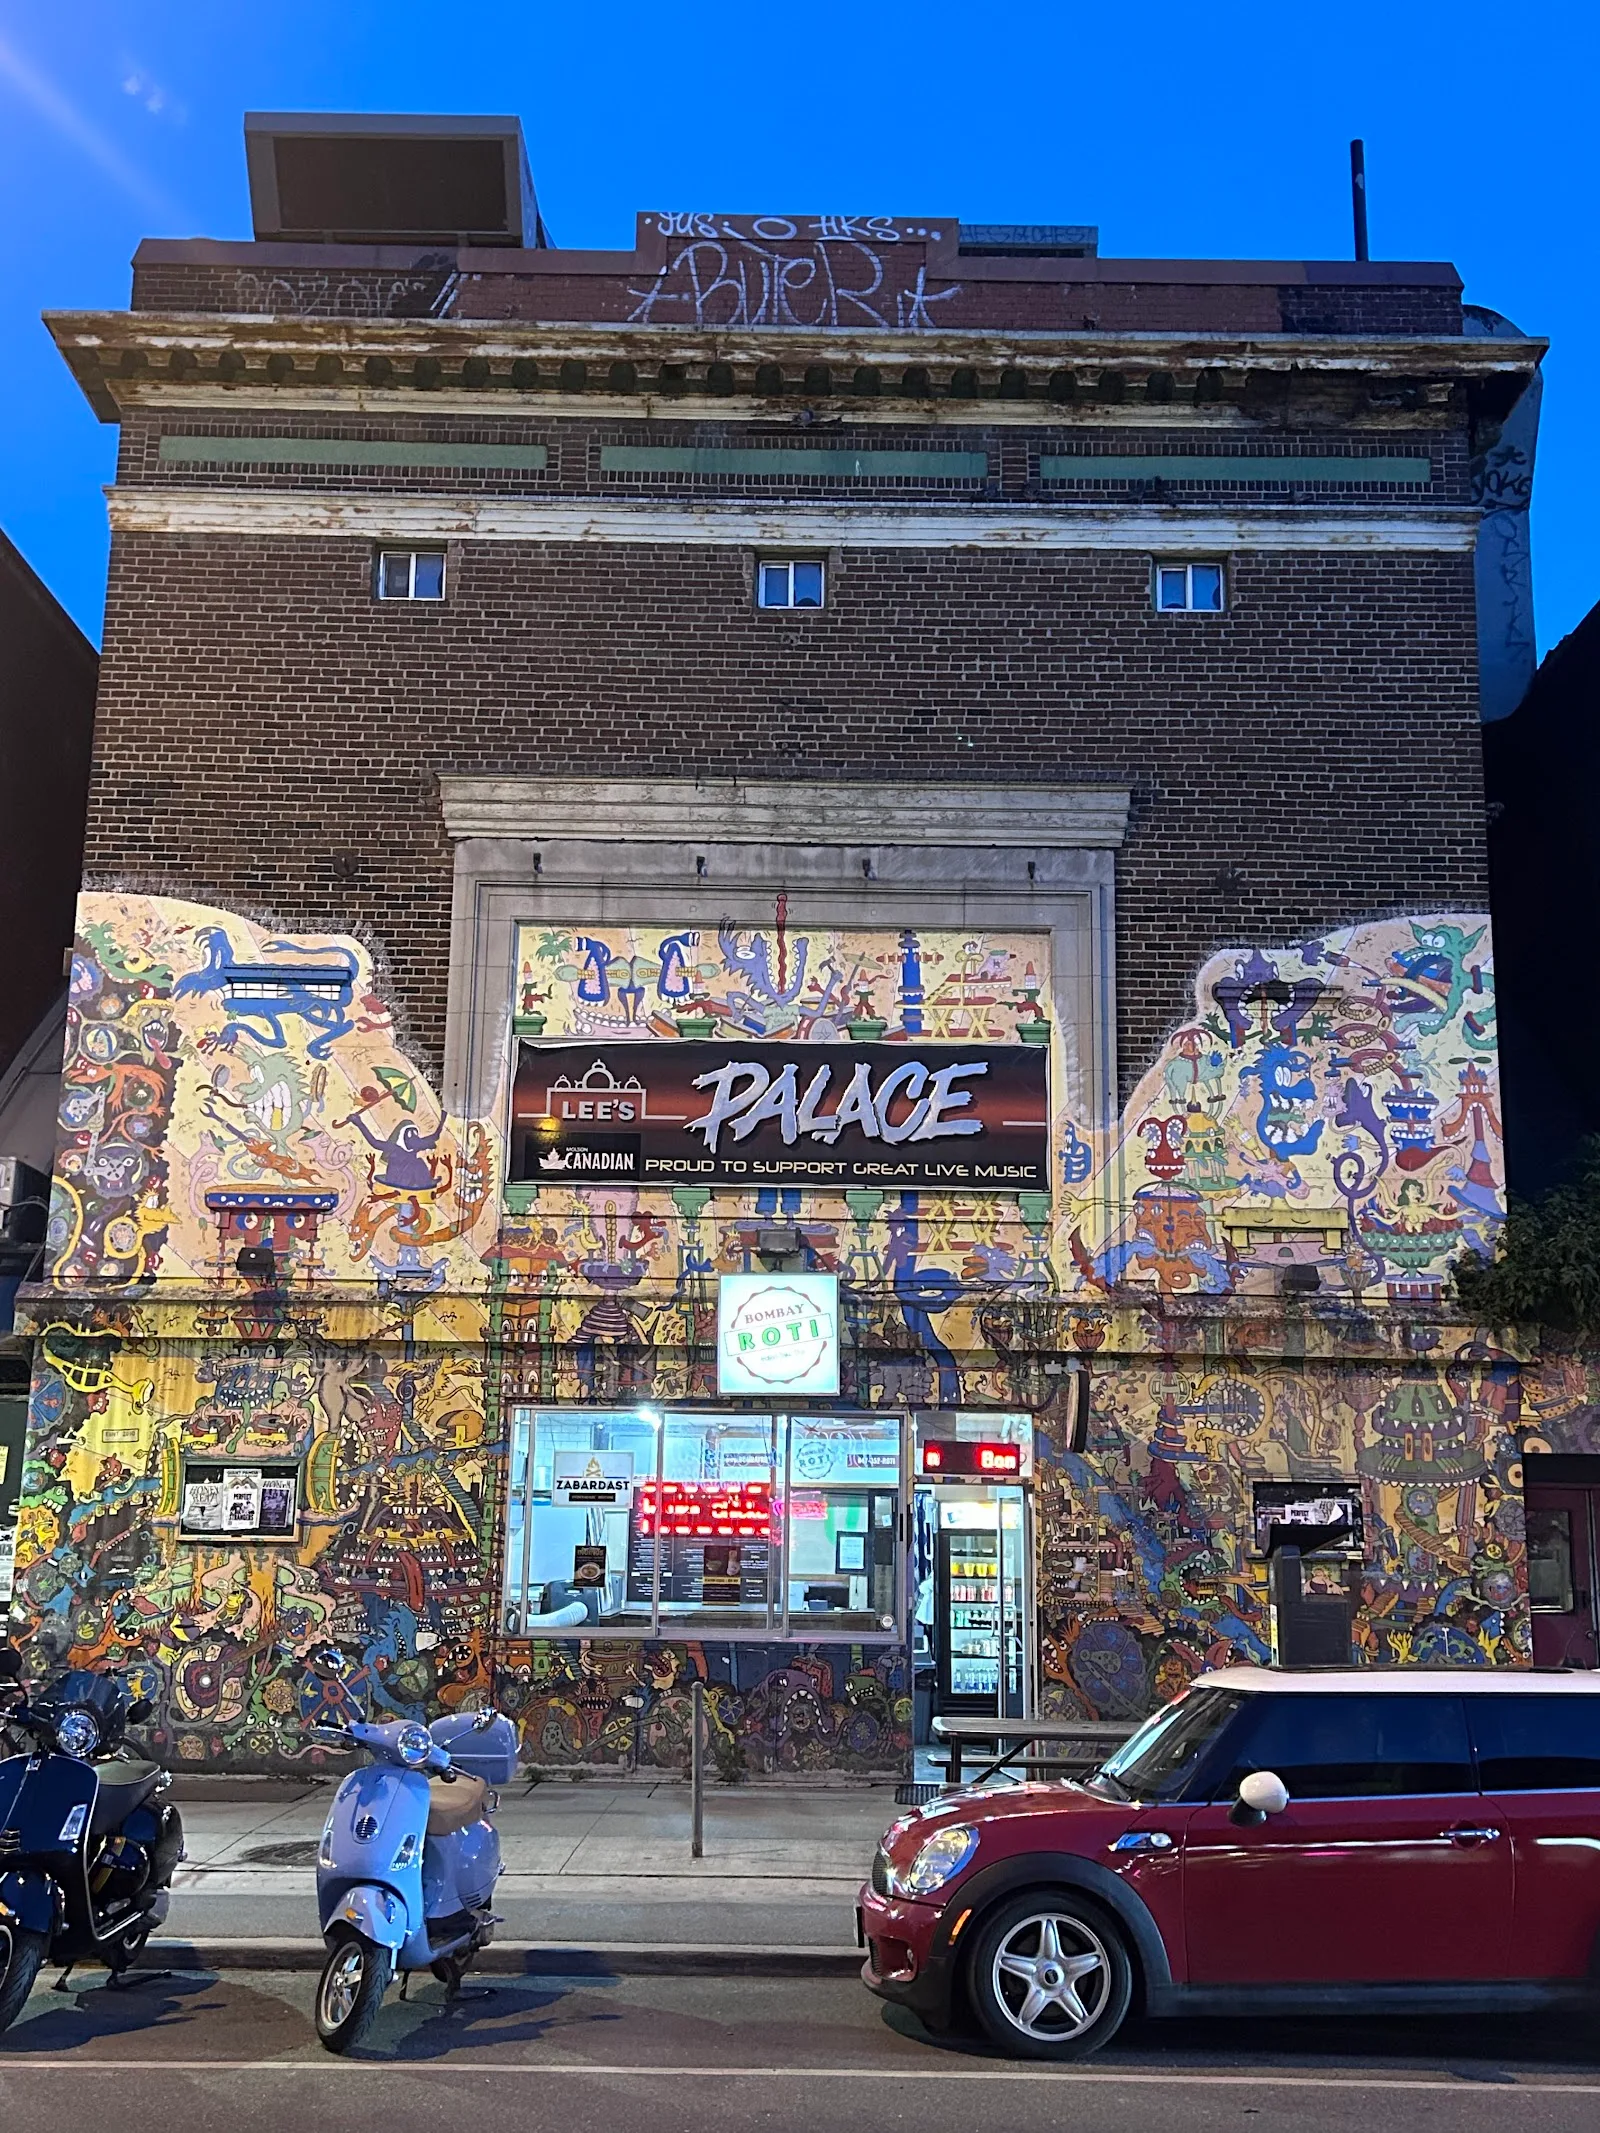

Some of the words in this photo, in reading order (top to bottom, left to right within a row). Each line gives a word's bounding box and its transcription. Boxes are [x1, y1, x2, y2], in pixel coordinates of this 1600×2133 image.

[561, 1098, 636, 1121] LEE'S
[683, 1061, 989, 1157] PALACE
[564, 1152, 634, 1171] CANADIAN
[645, 1159, 715, 1173] PROUD
[721, 1160, 747, 1173] TO
[753, 1161, 848, 1175] SUPPORT
[853, 1162, 919, 1176] GREAT
[924, 1164, 969, 1177] LIVE
[974, 1165, 1037, 1178] MUSIC
[744, 1303, 804, 1324] BOMBAY
[737, 1319, 819, 1351] ROTI
[556, 1480, 630, 1490] ZABARDAST
